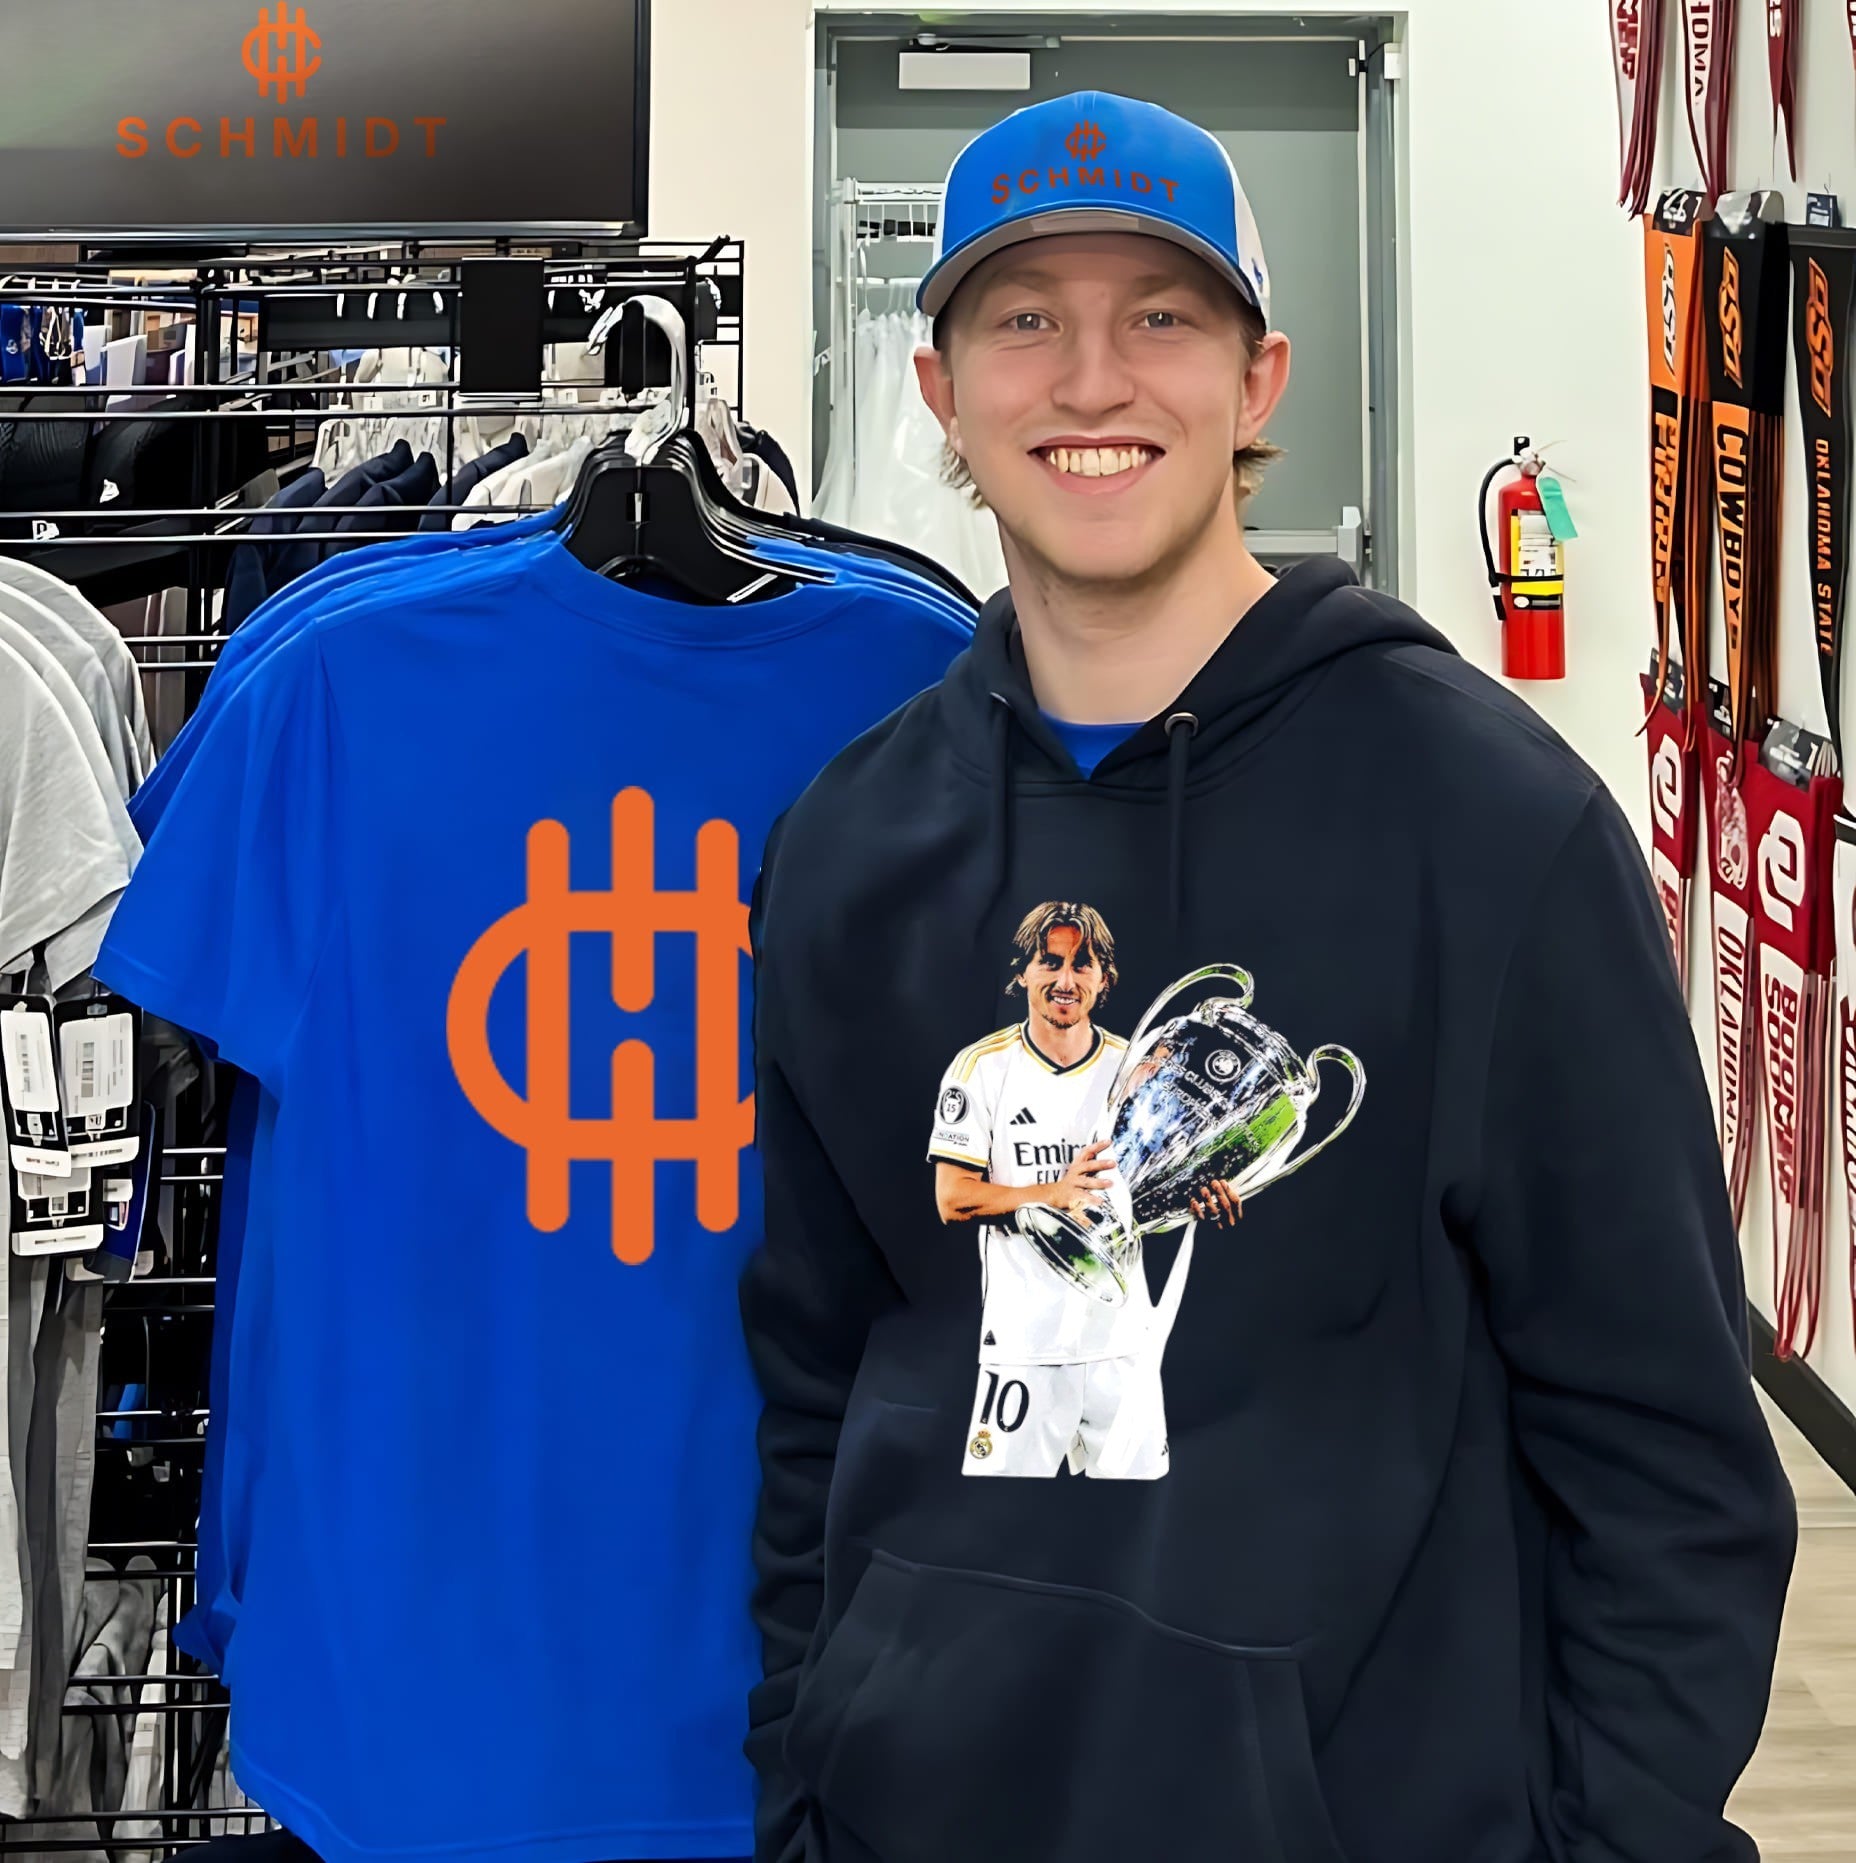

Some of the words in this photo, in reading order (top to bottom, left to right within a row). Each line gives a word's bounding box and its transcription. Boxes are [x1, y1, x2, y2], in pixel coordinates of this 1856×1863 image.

[115, 116, 447, 158] SCHMIDT
[992, 167, 1179, 205] SCHMIDT
[1814, 438, 1833, 571] OKLAHOMA
[1717, 925, 1745, 1144] OKLAHOMA
[946, 1103, 956, 1113] 15
[1013, 1138, 1087, 1167] Emir
[980, 1370, 1030, 1433] 10
